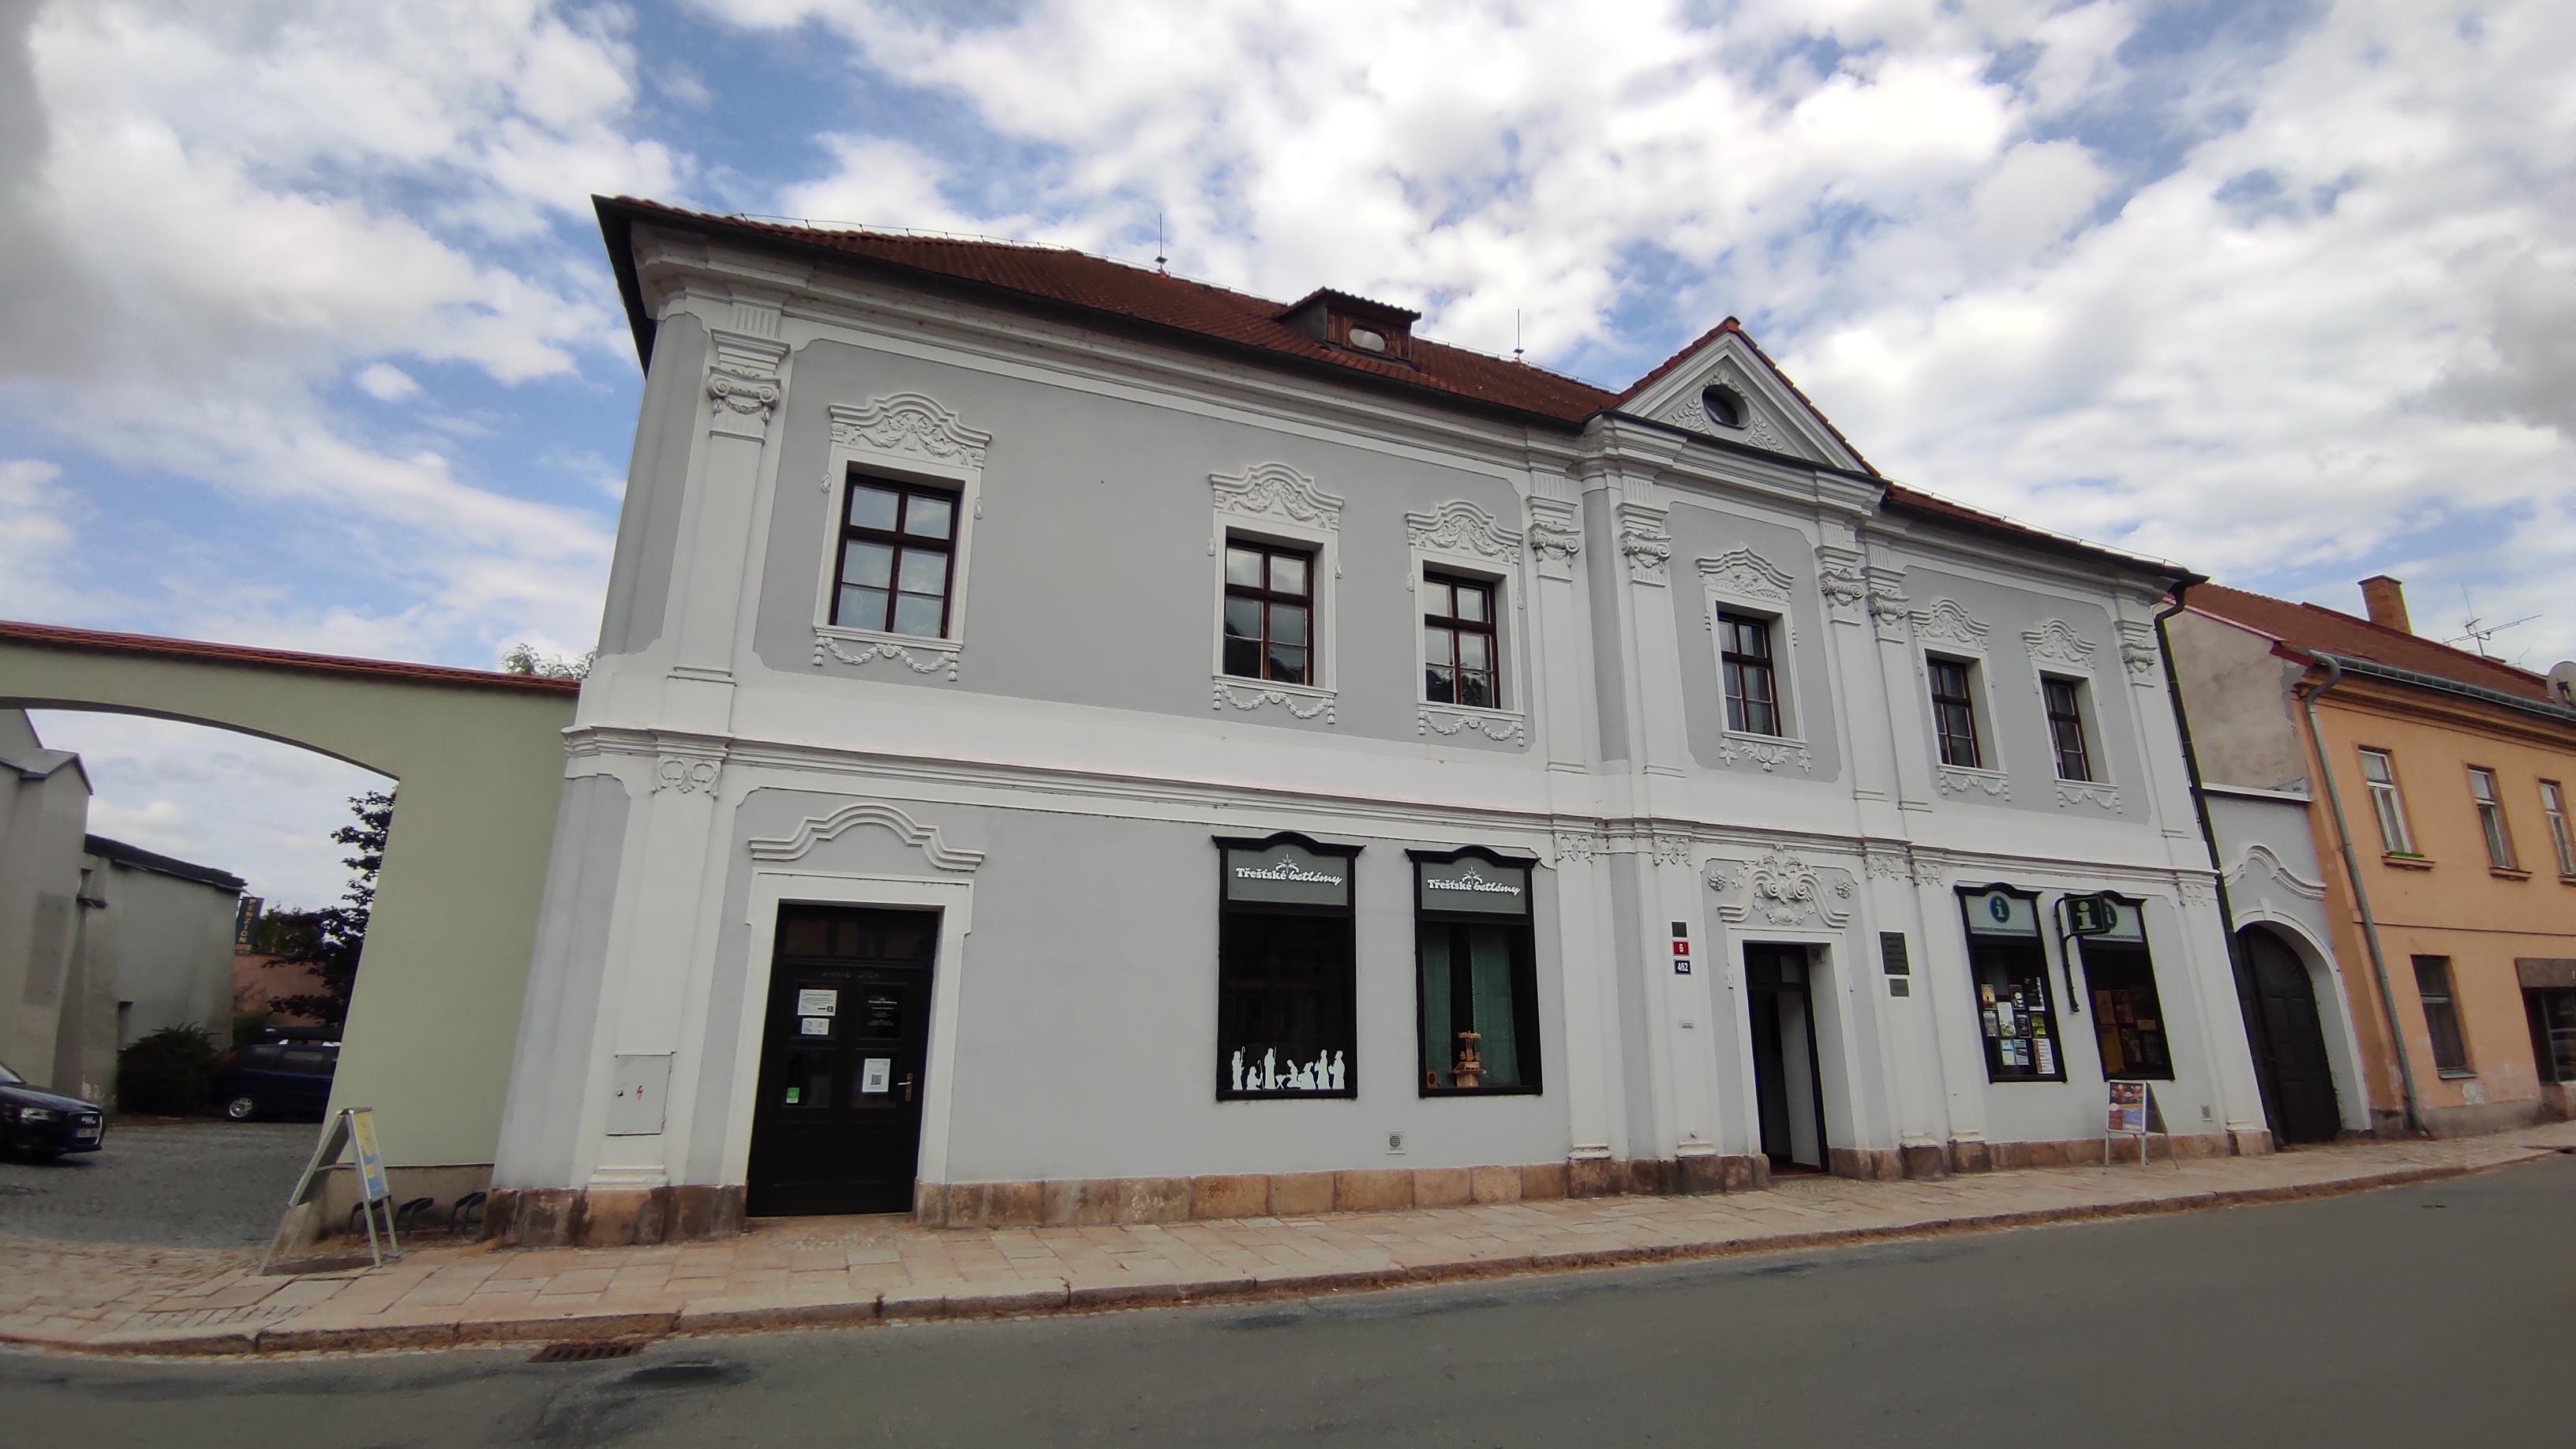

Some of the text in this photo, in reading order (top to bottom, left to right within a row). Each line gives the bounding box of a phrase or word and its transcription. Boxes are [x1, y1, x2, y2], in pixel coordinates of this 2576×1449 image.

[1236, 867, 1342, 886] Třešťské betlémy
[1427, 879, 1521, 897] Třešťské betlémy
[1679, 943, 1684, 953] 6
[1677, 962, 1689, 972] 462
